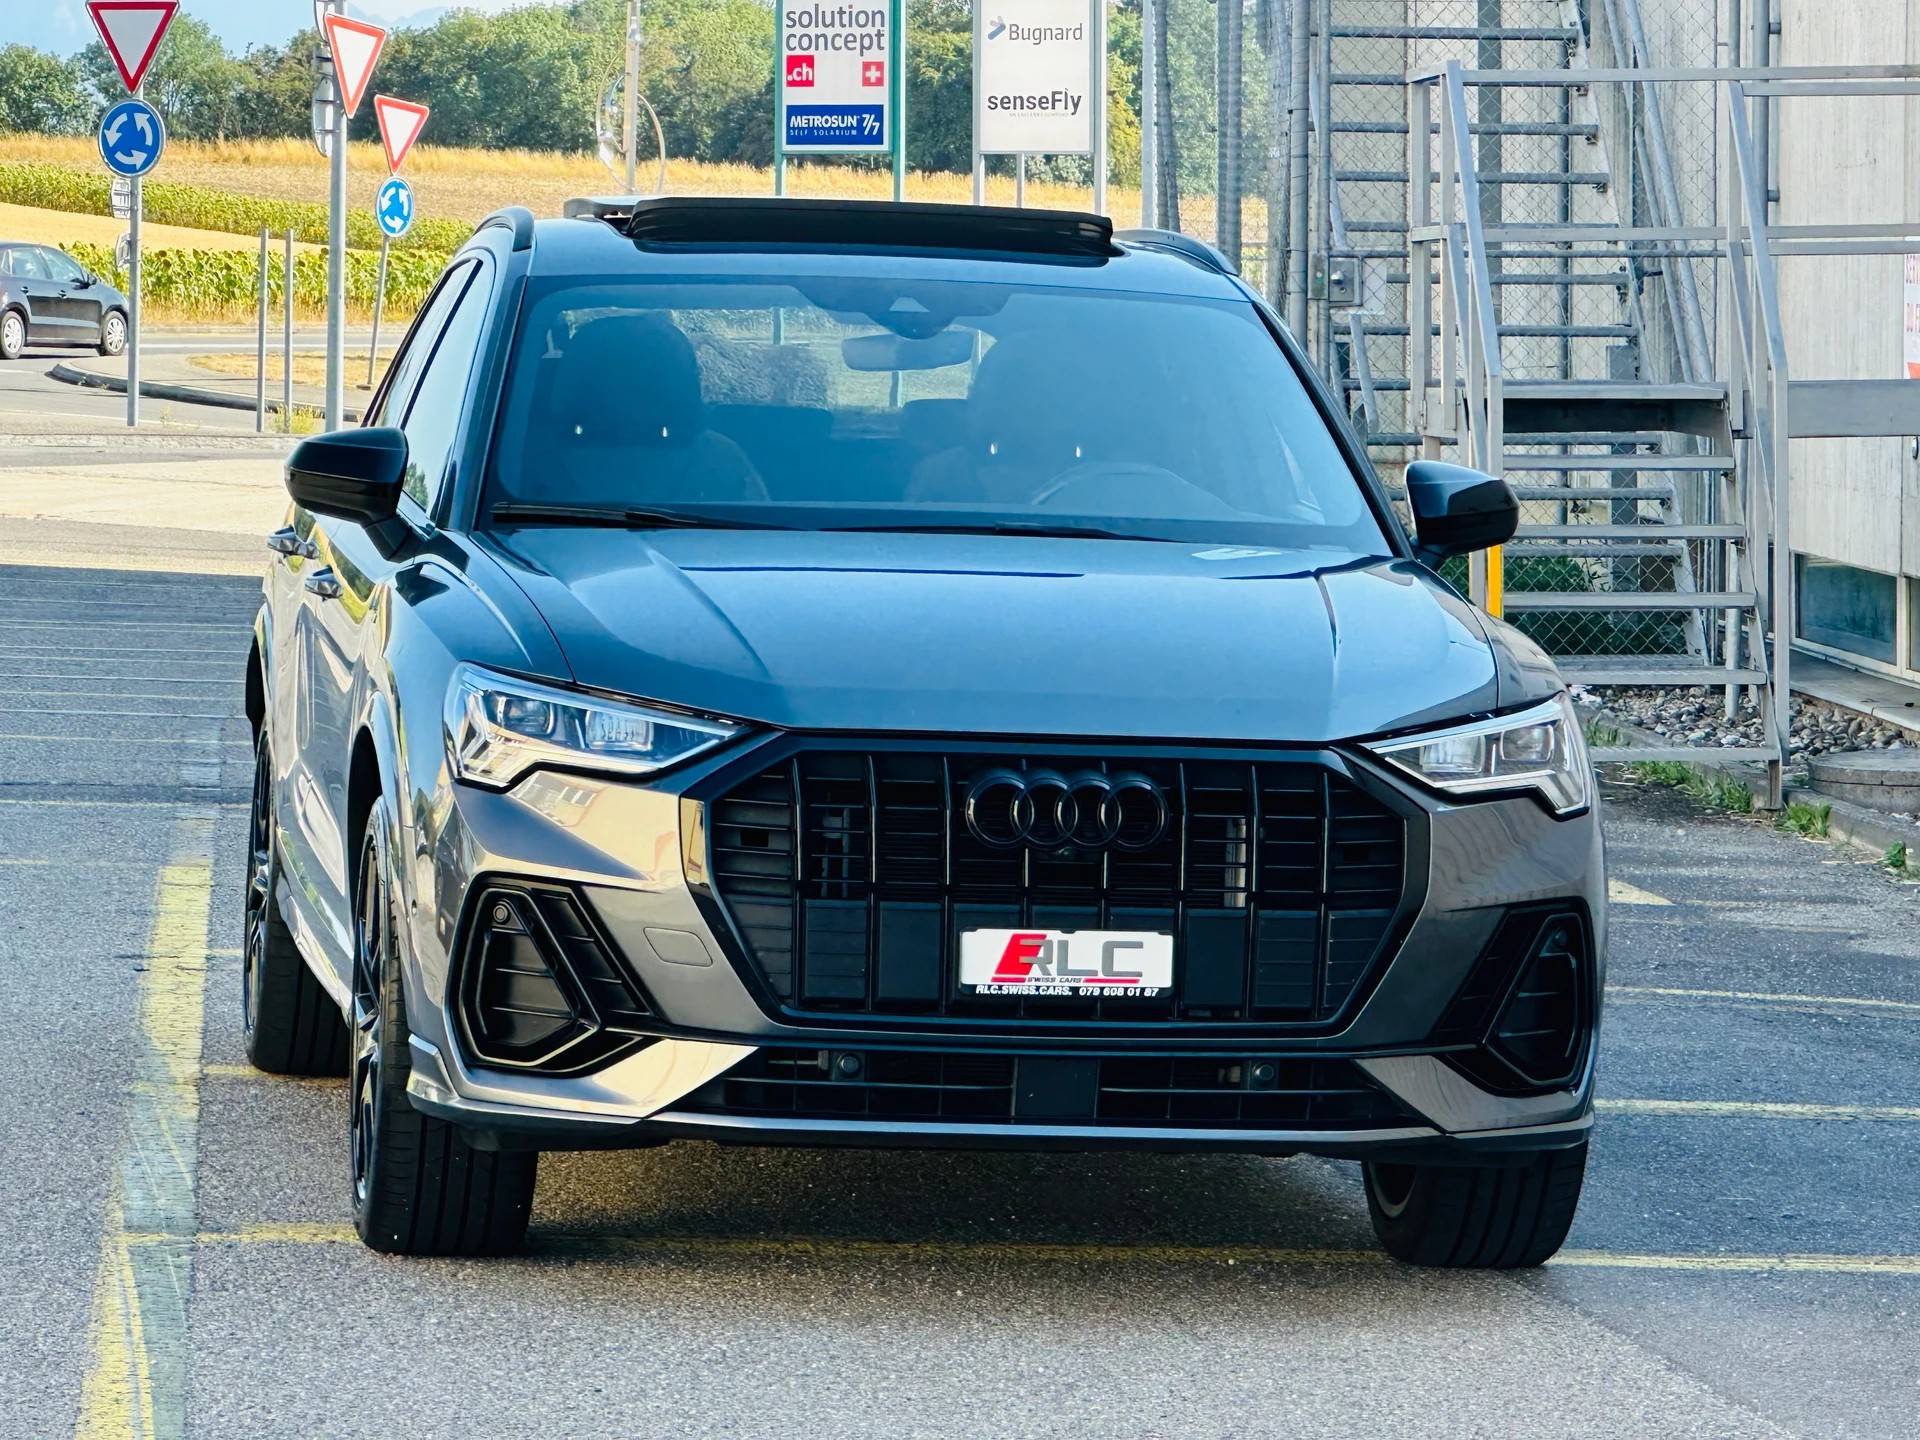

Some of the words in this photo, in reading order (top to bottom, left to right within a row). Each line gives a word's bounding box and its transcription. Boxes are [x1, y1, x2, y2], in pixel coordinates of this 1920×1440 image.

[786, 3, 885, 28] solution
[786, 29, 885, 57] concept
[1009, 23, 1083, 46] Bugnard
[787, 62, 813, 81] .ch
[987, 88, 1082, 116] senseFly
[790, 115, 857, 128] METROSUN
[862, 114, 880, 136] 7/7
[1079, 987, 1100, 996] 079
[1127, 987, 1141, 997] 01
[1144, 987, 1159, 997] 87
